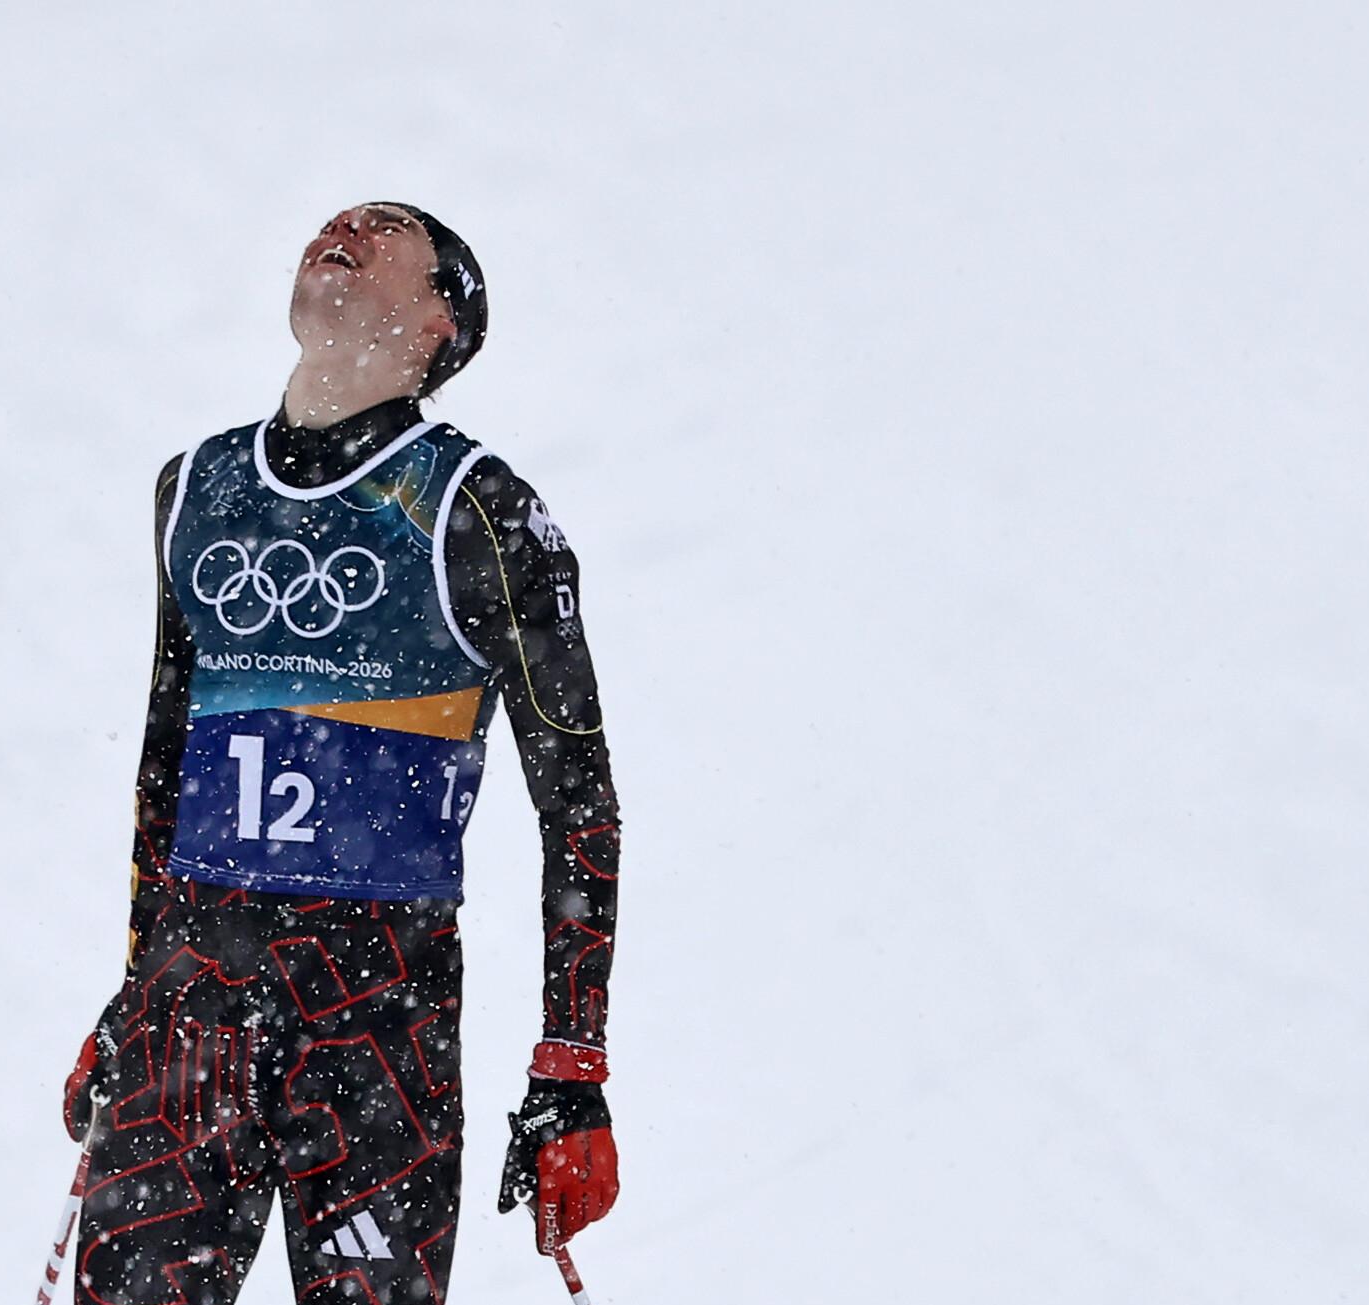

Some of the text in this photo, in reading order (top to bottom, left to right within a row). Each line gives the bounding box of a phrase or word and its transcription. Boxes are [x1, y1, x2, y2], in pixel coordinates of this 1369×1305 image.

[196, 652, 393, 679] MILANO CORTINA 2026
